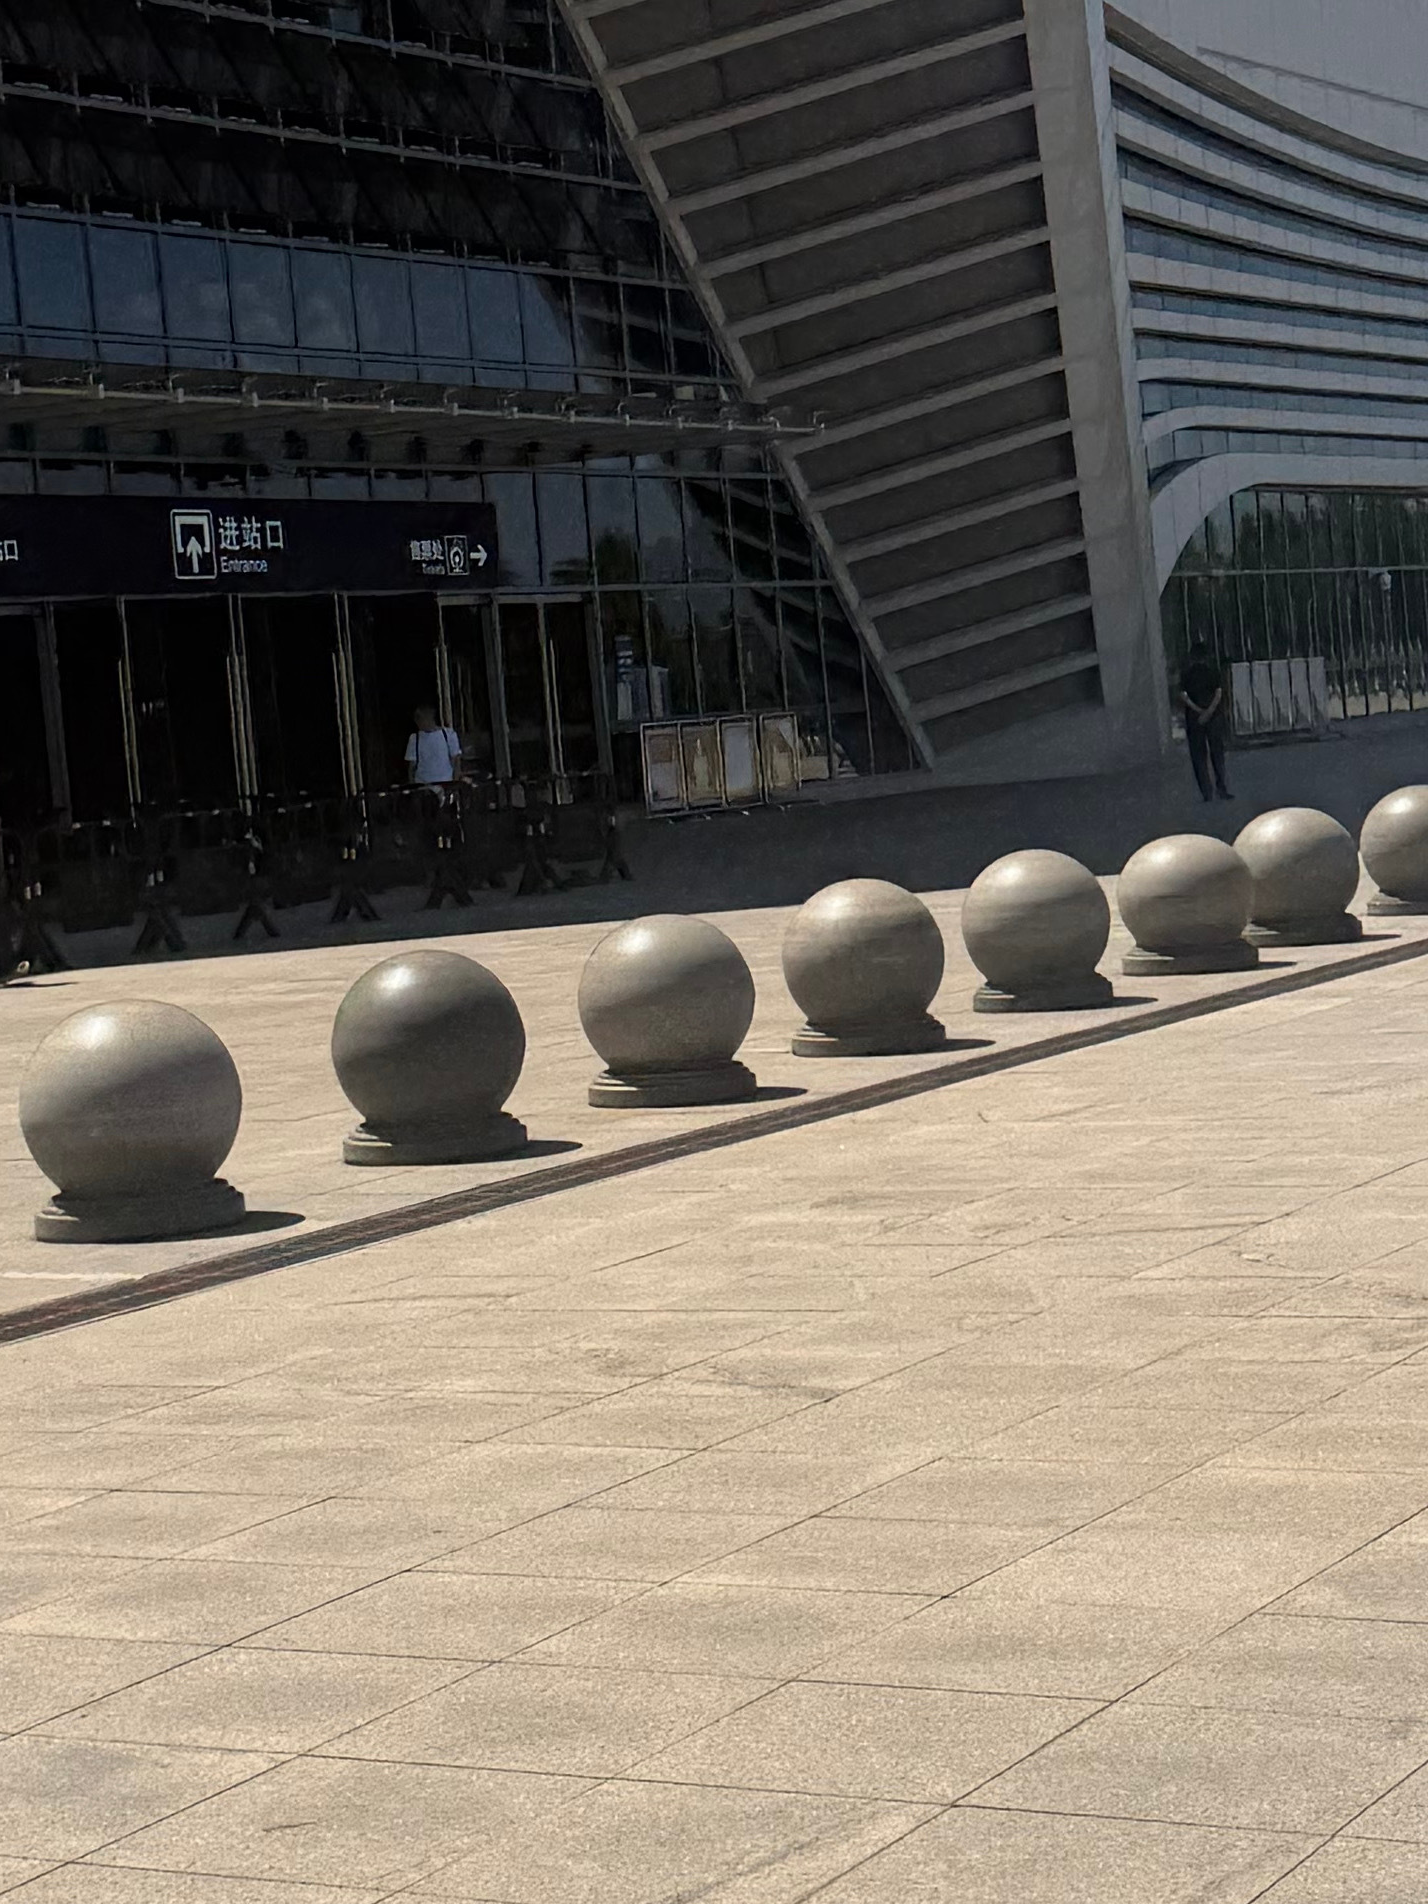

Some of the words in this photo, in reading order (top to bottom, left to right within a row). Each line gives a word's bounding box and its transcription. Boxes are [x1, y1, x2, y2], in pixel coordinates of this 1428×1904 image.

[218, 515, 284, 551] 进站口
[220, 556, 269, 573] Entrance
